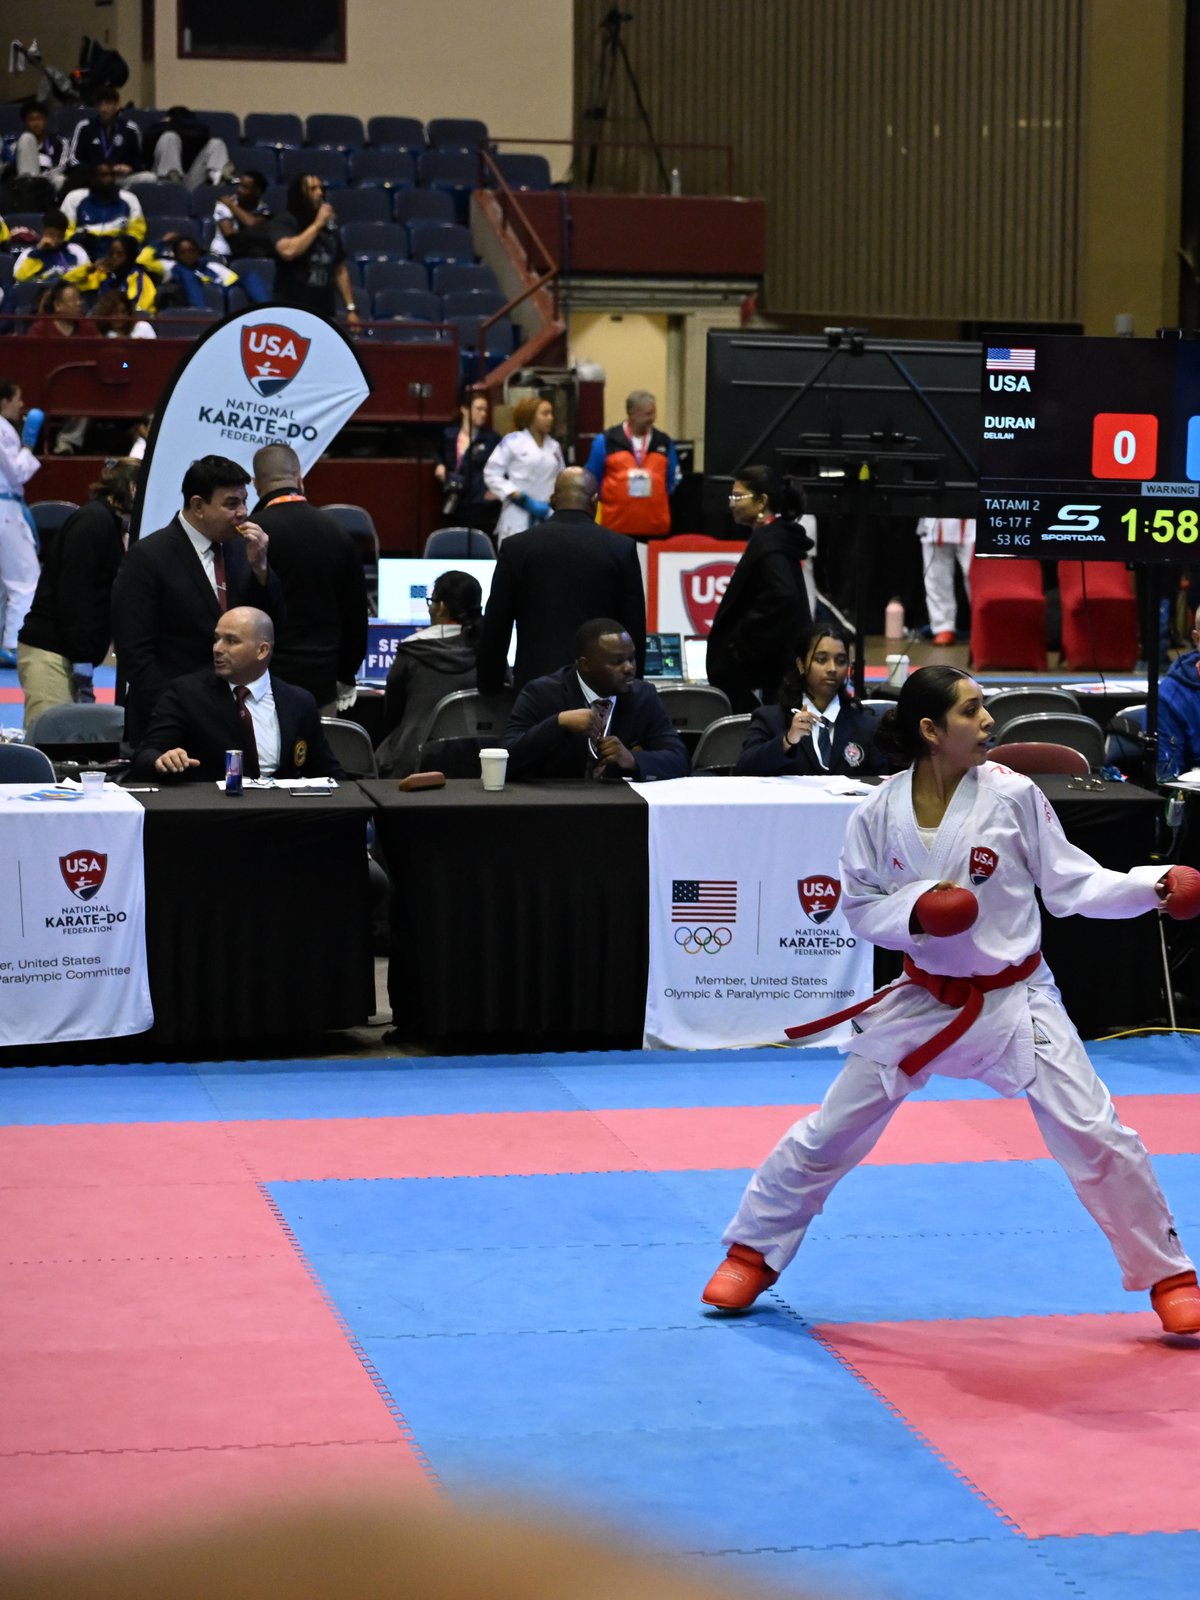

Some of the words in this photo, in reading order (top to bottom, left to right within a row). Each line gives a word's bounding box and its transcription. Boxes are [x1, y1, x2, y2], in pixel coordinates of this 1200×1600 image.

[248, 332, 298, 360] USA
[988, 375, 1031, 392] USA
[225, 398, 296, 420] NATIONAL
[198, 406, 318, 441] KARATE-DO
[984, 416, 1036, 429] DURAN
[1113, 430, 1136, 465] 0
[1146, 486, 1195, 495] WARNING
[985, 499, 1030, 511] TATAMI
[1032, 500, 1040, 511] 2
[989, 516, 1022, 528] 16-17
[1025, 517, 1032, 528] F
[992, 534, 1011, 545] -53
[1014, 534, 1031, 546] KG
[1041, 533, 1106, 541] SPORTDATA
[691, 575, 732, 604] US
[378, 638, 399, 653] SE
[368, 654, 397, 668] FIN
[973, 850, 994, 867] USA
[66, 858, 102, 873] USA
[803, 883, 836, 897] USA
[62, 904, 111, 914] NATIONAL
[45, 912, 127, 928] KARATE-DO
[62, 926, 112, 935] FEDERATION
[795, 929, 841, 937] NATIONAL
[779, 938, 857, 948] KARATE-DO
[18, 957, 58, 969] United
[62, 956, 101, 966] States
[65, 966, 131, 980] Committee
[695, 976, 747, 987] Member,
[750, 976, 788, 985] United
[791, 976, 828, 986] States
[664, 988, 710, 1000] Olympic
[715, 989, 723, 998] &
[726, 989, 790, 1001] Paralympic
[793, 989, 855, 999] Committee
